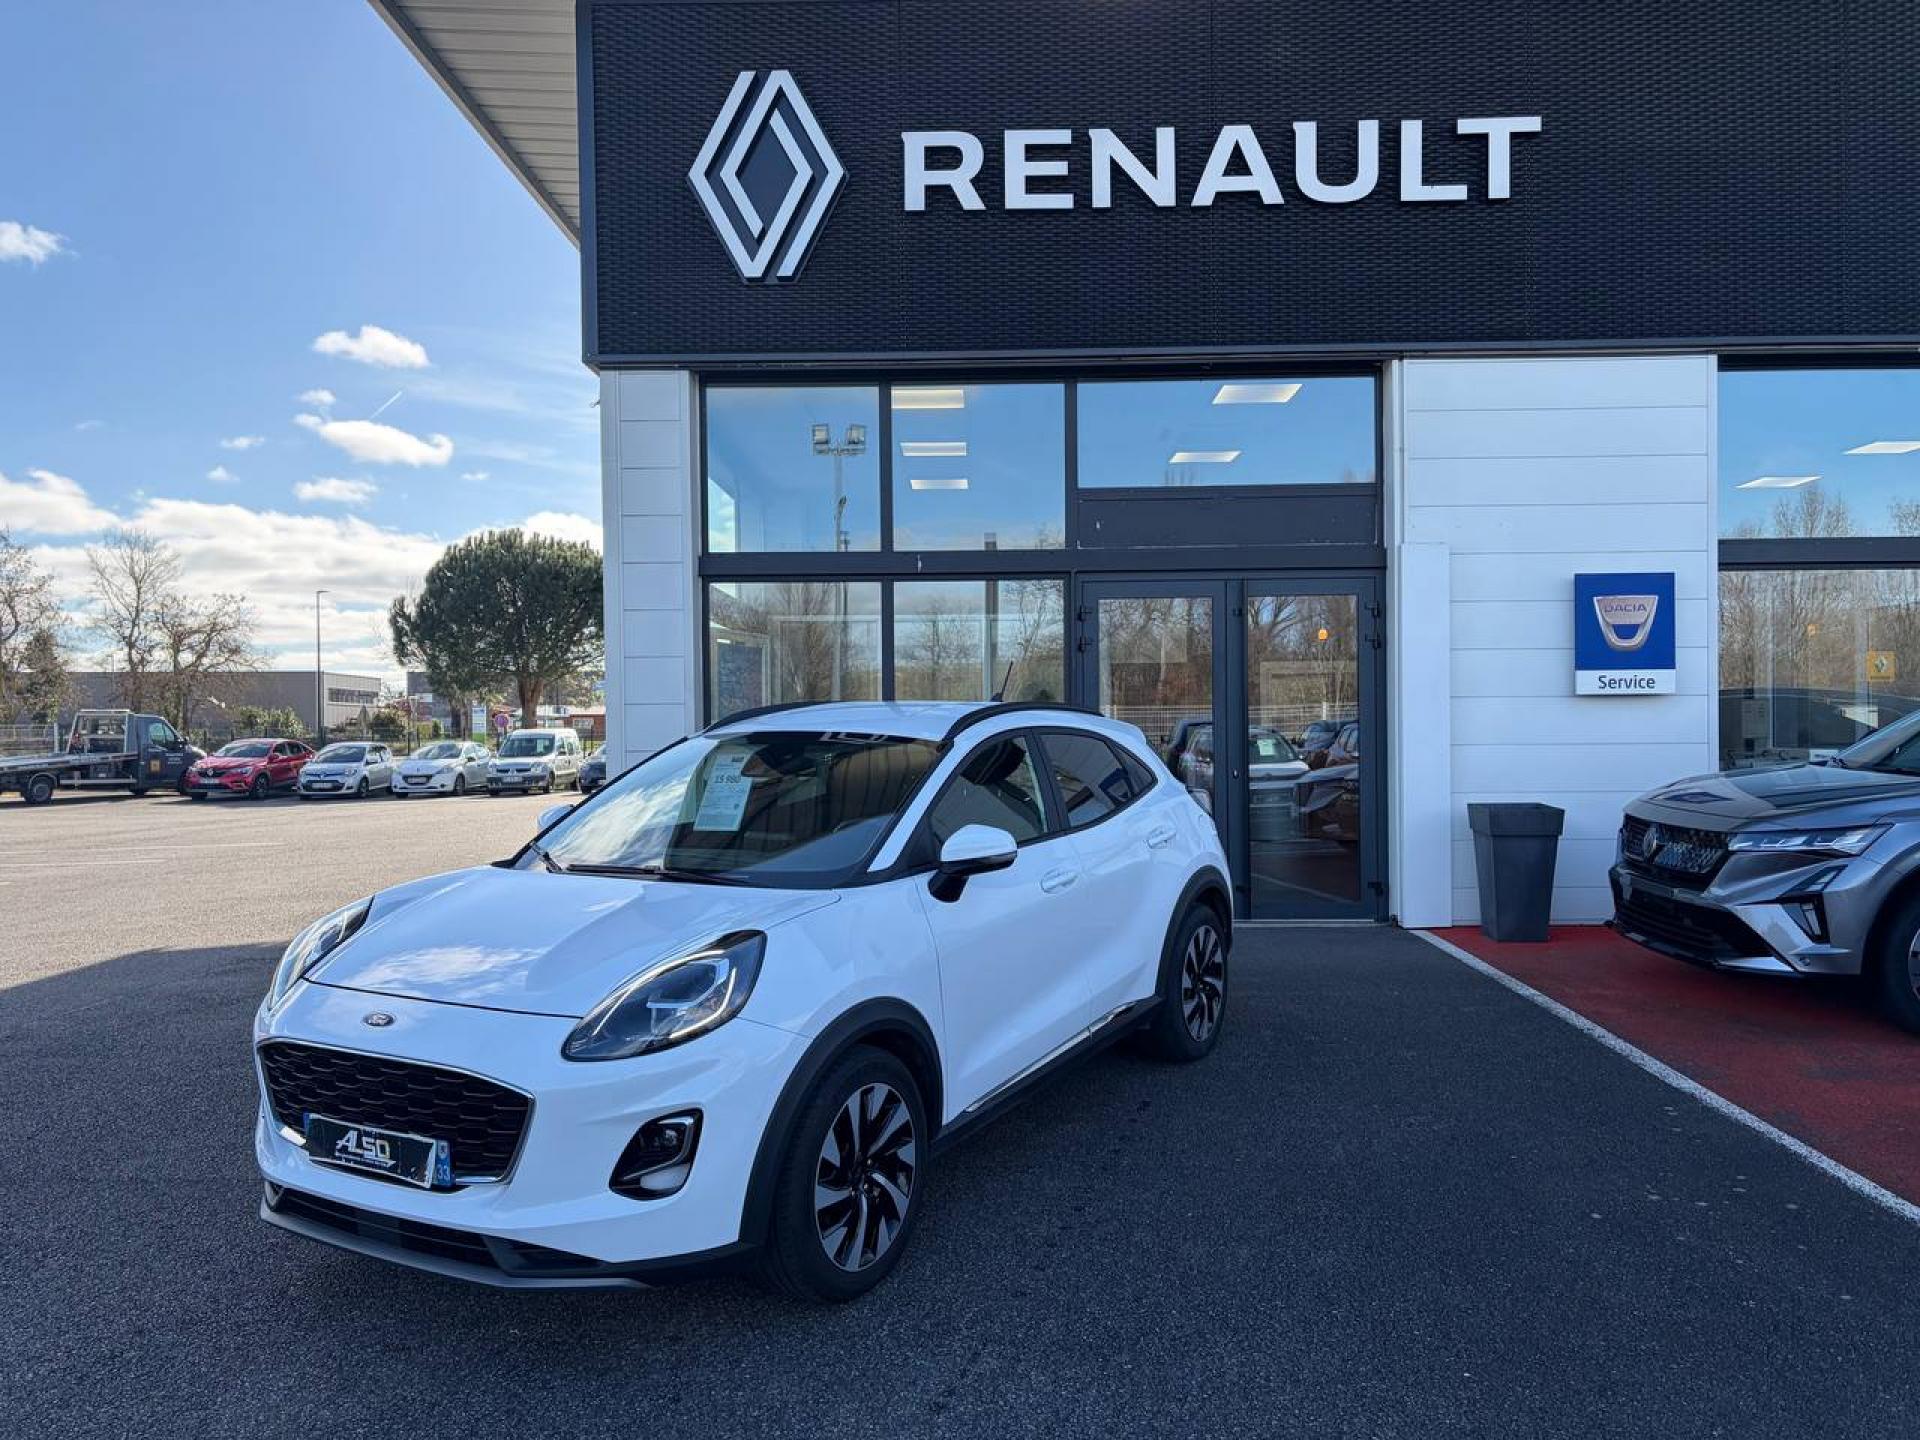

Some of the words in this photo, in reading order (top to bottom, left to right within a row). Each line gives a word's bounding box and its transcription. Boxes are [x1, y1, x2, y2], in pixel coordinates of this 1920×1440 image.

[901, 115, 1542, 211] RENAULT
[1603, 603, 1648, 613] DACIA
[1598, 674, 1656, 689] Service
